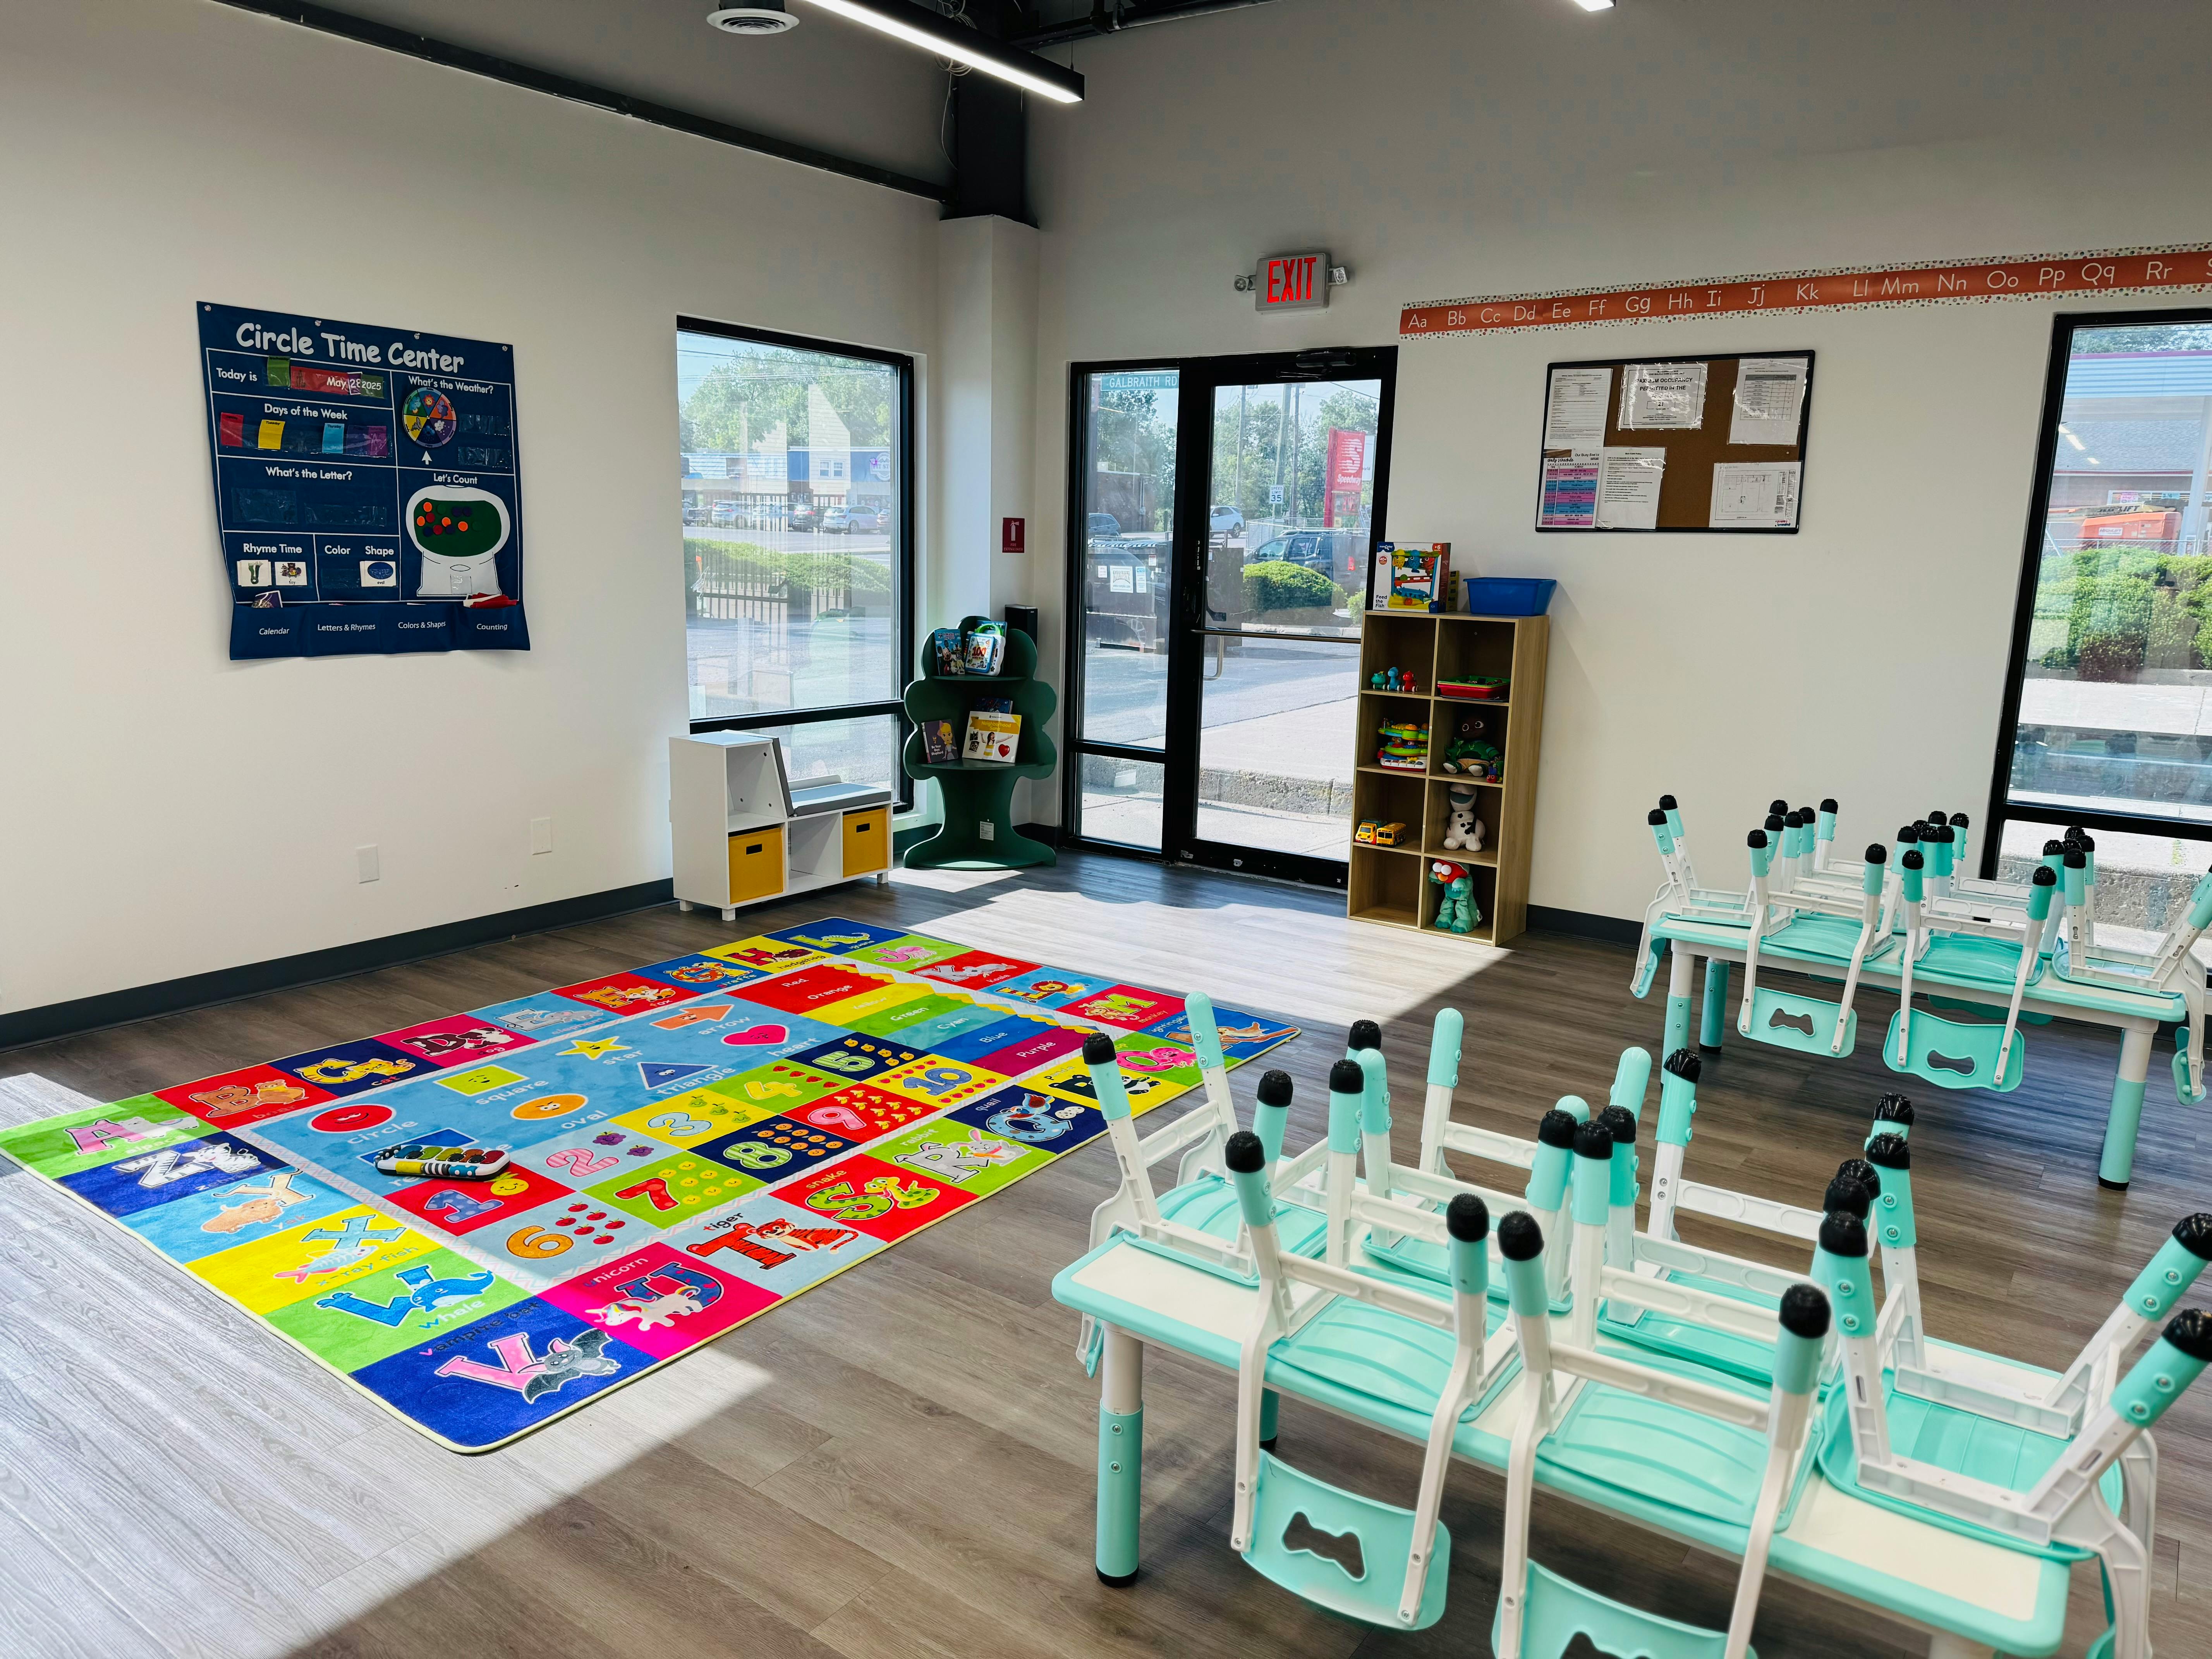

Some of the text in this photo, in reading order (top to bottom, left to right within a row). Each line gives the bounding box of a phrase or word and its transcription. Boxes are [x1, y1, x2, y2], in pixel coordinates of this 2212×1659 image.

[1267, 256, 1317, 303] EXIT
[1408, 261, 2172, 328] Aa Bb Cc Dd Ee Ff Gg Hh Ii Jj Kk Ll Mm Nn Oo Pp Qq Rr
[236, 322, 464, 374] Circle Time Center
[216, 368, 258, 382] Today is
[327, 377, 347, 390] May
[362, 381, 381, 390] 2025
[408, 376, 494, 394] What's the Weather?
[1109, 376, 1177, 388] GALBRAITH RD
[264, 404, 348, 420] Days of the Week
[266, 467, 352, 481] What's the Letter?
[433, 473, 477, 484] Let's Count
[1337, 474, 1361, 486] Speedway
[243, 543, 302, 555] Rhyme Time
[325, 545, 351, 555] Color
[365, 546, 394, 556] Shape
[351, 623, 376, 632] Rhymes
[427, 621, 446, 630] Shapes
[476, 623, 508, 631] Counting
[972, 646, 986, 656] 100
[723, 948, 776, 966] H
[777, 955, 826, 969] hedgehog
[781, 978, 810, 988] Red
[807, 984, 853, 1001] Orange
[890, 1006, 929, 1022] Green
[1095, 993, 1158, 1016] M
[697, 1015, 752, 1036] arrow
[936, 1017, 969, 1031] Cyan
[1138, 1010, 1168, 1023] monkey
[400, 1032, 467, 1056] D
[767, 1036, 821, 1058] heart
[979, 1031, 1008, 1044] Blue
[478, 1046, 506, 1056] dog
[603, 1049, 644, 1066] star
[1016, 1040, 1057, 1060] Purple
[293, 1058, 367, 1084] C
[812, 1051, 874, 1072] 5
[371, 1076, 399, 1087] cat
[475, 1079, 550, 1105] square
[657, 1067, 737, 1097] triangle
[744, 1080, 804, 1100] 4
[903, 1067, 972, 1096] 10
[189, 1085, 260, 1118] B
[975, 1097, 1001, 1113] quail
[561, 1109, 608, 1129] oval
[648, 1111, 712, 1137] 3
[807, 1106, 867, 1130] 9
[986, 1111, 1073, 1142] Q
[64, 1118, 147, 1155] A
[347, 1119, 419, 1145] circle
[900, 1127, 938, 1147] rabbit
[126, 1134, 188, 1155] alpaca
[723, 1141, 793, 1169] 8
[112, 1150, 214, 1188] Z
[546, 1148, 619, 1177] 2
[892, 1142, 989, 1184] R
[805, 1168, 847, 1190] snake
[615, 1177, 679, 1211] 7
[805, 1181, 894, 1220] S
[425, 1189, 504, 1223] 1
[301, 1214, 407, 1250] X
[703, 1212, 744, 1233] tiger
[507, 1225, 574, 1259] 6
[686, 1223, 797, 1270] T
[316, 1245, 419, 1287] x-ray fish
[583, 1257, 649, 1288] unicorn
[614, 1262, 724, 1313] U
[418, 1299, 486, 1329] whale
[419, 1302, 542, 1356] vampire bat
[434, 1332, 543, 1393] V
